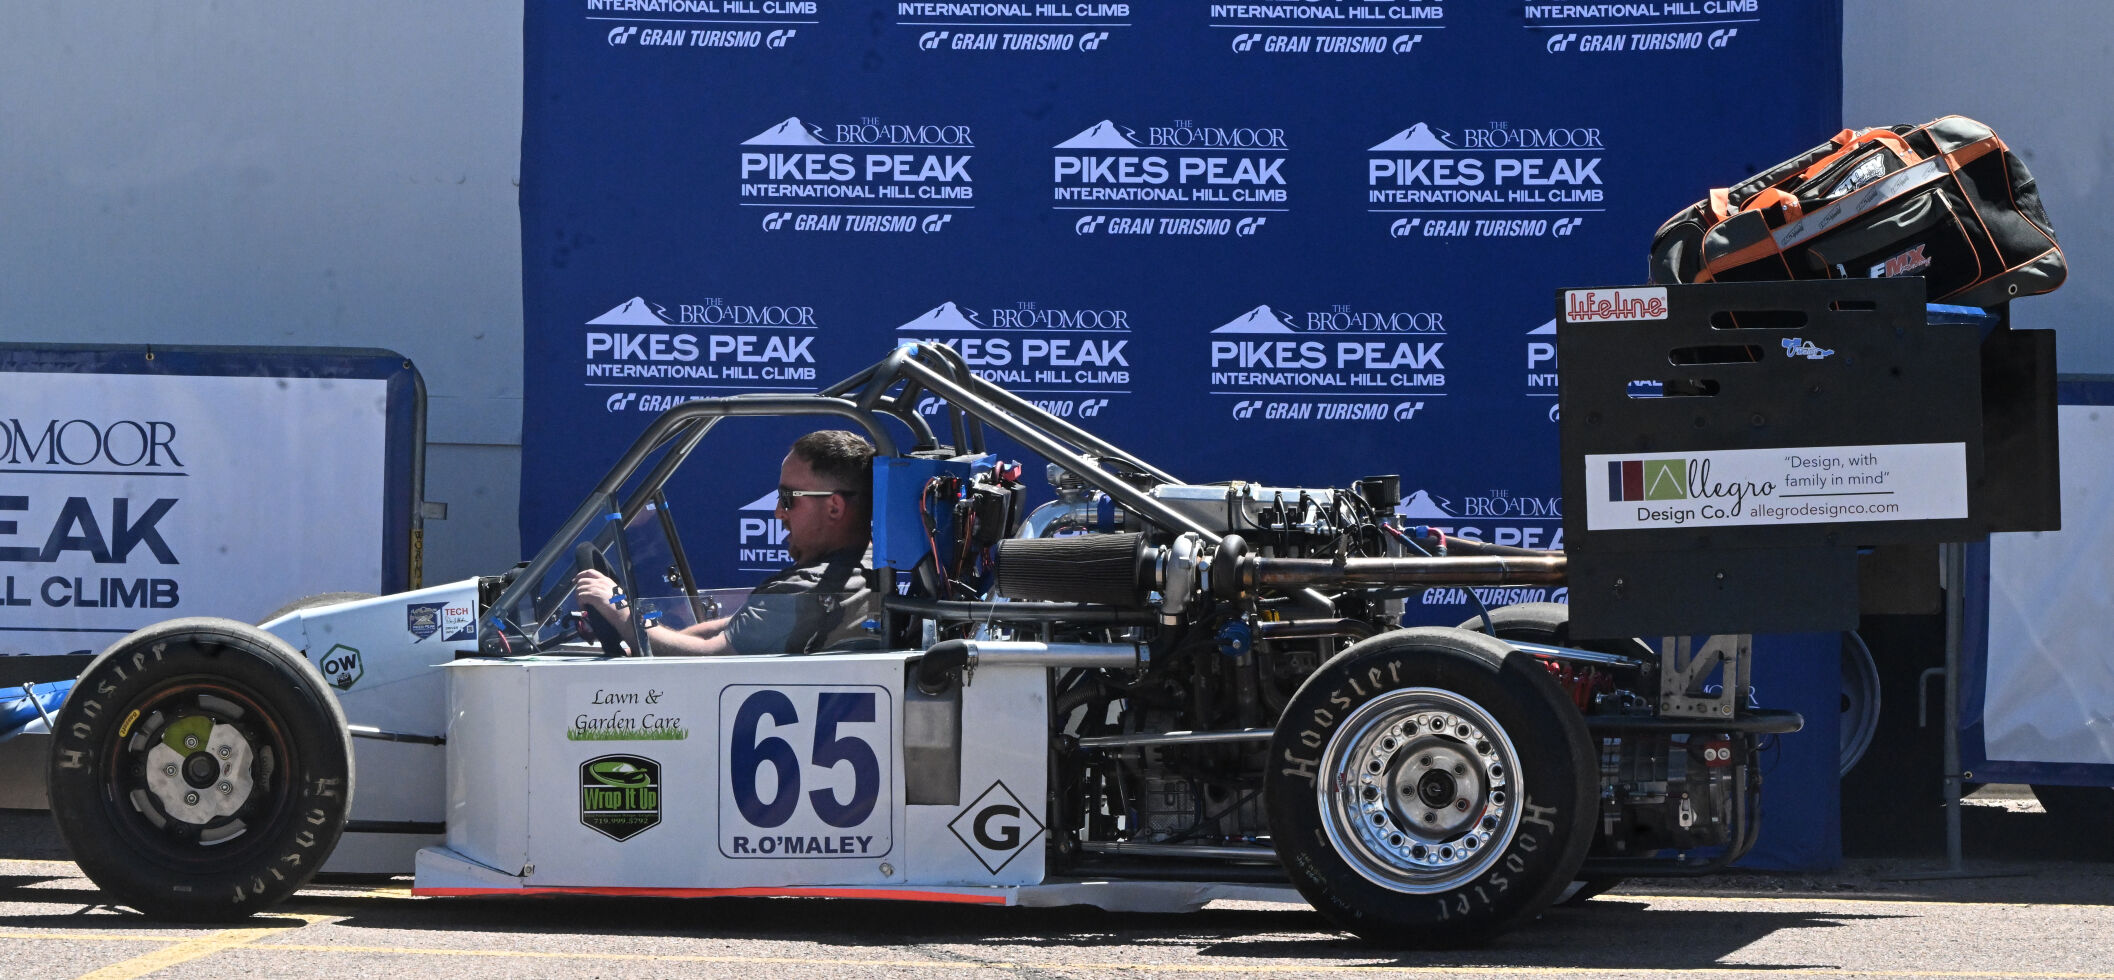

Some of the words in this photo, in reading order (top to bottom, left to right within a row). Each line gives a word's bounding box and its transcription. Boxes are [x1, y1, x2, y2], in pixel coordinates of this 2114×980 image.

[588, 0, 719, 13] INTERNATIONAL
[724, 1, 759, 13] HILL
[763, 1, 817, 14] CLIMB
[899, 3, 1032, 16] INTERNATIONAL
[1036, 4, 1072, 16] HILL
[1076, 4, 1129, 16] CLIMB
[1211, 5, 1345, 18] INTERNATIONAL
[1349, 7, 1385, 18] HILL
[1389, 6, 1443, 19] CLIMB
[1525, 4, 1660, 18] INTERNATIONAL
[1664, 2, 1700, 15] HILL
[1704, 0, 1758, 13] CLIMB
[640, 29, 686, 46] GRAN
[691, 30, 761, 47] TURISMO
[952, 34, 998, 49] GRAN
[1003, 34, 1074, 50] TURISMO
[1265, 36, 1311, 52] GRAN
[1316, 37, 1387, 52] TURISMO
[1580, 35, 1626, 51] GRAN
[1631, 32, 1702, 50] TURISMO
[861, 116, 880, 125] THE
[1174, 119, 1193, 127] THE
[1489, 120, 1508, 128] THE
[836, 125, 972, 144] BROADMOOR
[1150, 128, 1286, 146] BROADMOOR
[1464, 129, 1603, 147] BROADMOOR
[742, 153, 855, 181] PIKES
[866, 155, 972, 181] PEAK
[1055, 157, 1169, 184] PIKES
[1180, 158, 1286, 184] PEAK
[1370, 159, 1484, 186] PIKES
[1496, 158, 1603, 185] PEAK
[742, 184, 875, 197] INTERNATIONAL
[879, 186, 915, 198] HILL
[919, 186, 972, 198] CLIMB
[1055, 188, 1188, 200] INTERNATIONAL
[1193, 189, 1229, 201] HILL
[1233, 189, 1287, 201] CLIMB
[1370, 190, 1504, 202] INTERNATIONAL
[1509, 190, 1545, 202] HILL
[1549, 190, 1603, 202] CLIMB
[795, 215, 841, 231] GRAN
[846, 215, 917, 232] TURISMO
[1108, 218, 1154, 234] GRAN
[1160, 219, 1231, 235] TURISMO
[1424, 220, 1470, 236] GRAN
[1475, 220, 1547, 236] TURISMO
[1870, 244, 1926, 279] FMX
[705, 298, 724, 306] THE
[1017, 301, 1036, 309] THE
[1331, 304, 1350, 312] THE
[680, 305, 816, 325] BROADMOOR
[993, 309, 1129, 328] BROADMOOR
[1307, 313, 1445, 331] BROADMOOR
[587, 333, 699, 361] PIKES
[710, 335, 815, 362] PEAK
[1023, 339, 1129, 366] PEAK
[1212, 342, 1326, 369] PIKES
[1338, 343, 1444, 368] PEAK
[587, 364, 718, 378] INTERNATIONAL
[723, 367, 758, 379] HILL
[762, 367, 816, 379] CLIMB
[1036, 371, 1072, 383] HILL
[1075, 371, 1129, 383] CLIMB
[1212, 373, 1346, 385] INTERNATIONAL
[1351, 374, 1387, 385] HILL
[1391, 374, 1445, 386] CLIMB
[1266, 403, 1312, 419] GRAN
[1317, 404, 1388, 419] TURISMO
[1848, 453, 1877, 467] with
[1785, 473, 1825, 490] family
[1831, 474, 1844, 485] in
[1490, 489, 1508, 498] THE
[1637, 505, 1695, 523] Design
[1701, 504, 1730, 519] Co.
[1750, 501, 1899, 518] allegrodesignco.com
[40, 576, 180, 608] CLIMB
[1422, 588, 1467, 605] GRAN
[1474, 588, 1546, 605] TURISMO
[445, 608, 469, 616] TECH
[325, 654, 356, 675] OW
[592, 689, 639, 705] Lawn
[645, 689, 664, 704] &
[59, 642, 167, 774] Hoosier
[575, 710, 636, 734] Garden
[642, 713, 681, 729] Care
[1282, 660, 1402, 788] Hoosier
[730, 689, 880, 829] 65
[584, 787, 622, 810] Wrap
[625, 787, 637, 810] It
[640, 787, 657, 810] Up
[973, 804, 1021, 851] G
[233, 773, 340, 904] Hoosier
[1437, 795, 1557, 920] Hoosier
